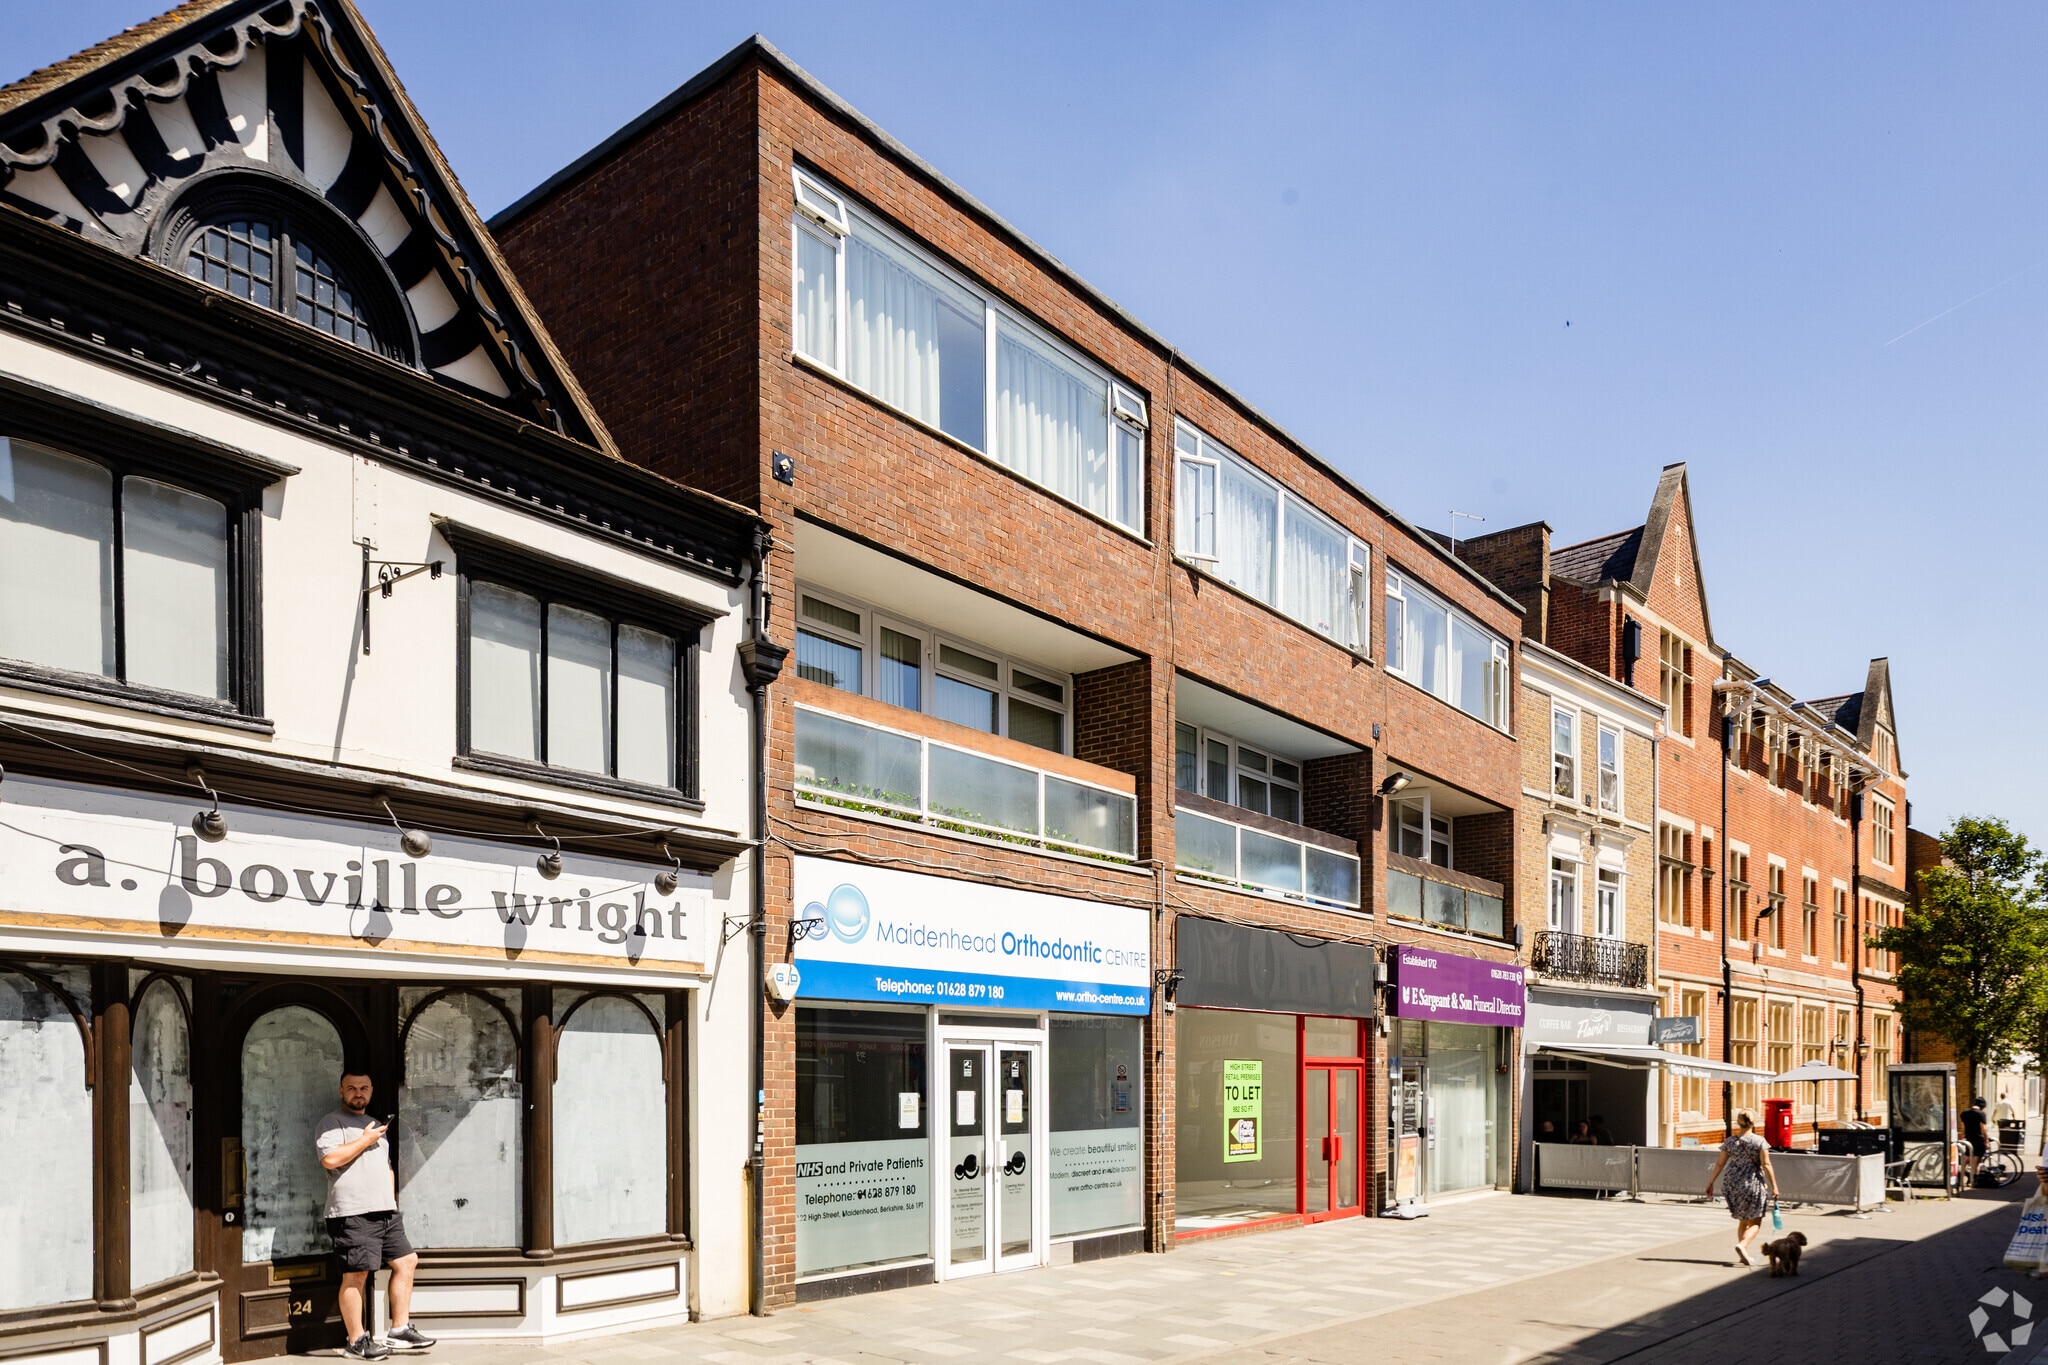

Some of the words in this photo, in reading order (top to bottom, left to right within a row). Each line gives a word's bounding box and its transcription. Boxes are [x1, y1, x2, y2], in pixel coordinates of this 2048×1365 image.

[55, 843, 137, 890] a.
[176, 834, 463, 919] boville
[491, 887, 687, 944] wright
[876, 920, 996, 953] Maidenhead
[1001, 931, 1102, 964] Orthodontic
[1105, 949, 1147, 968] CENTRE
[875, 977, 935, 996] Telephone:
[937, 980, 967, 997] 01628
[968, 983, 986, 998] 879
[988, 985, 1004, 999] 180
[1056, 990, 1146, 1007] www.ortho-centre.co.uk
[1419, 988, 1451, 1012] Sargeant
[1451, 992, 1458, 1009] &
[1459, 993, 1473, 1011] Son
[1473, 995, 1496, 1013] Funeral
[1496, 998, 1521, 1016] Directors
[1539, 1018, 1560, 1030] COFFEE
[1560, 1020, 1571, 1030] BAR
[1616, 1023, 1647, 1034] RESTAURANT
[1225, 1086, 1239, 1101] TO
[1243, 1086, 1261, 1100] LET
[1062, 1146, 1086, 1156] create
[1087, 1143, 1117, 1154] beautiful
[1117, 1142, 1137, 1151] smiles
[796, 1162, 823, 1178] NHS
[824, 1162, 846, 1175] and
[849, 1161, 884, 1173] Private
[886, 1157, 924, 1170] Patients
[1071, 1169, 1091, 1178] discreet
[1102, 1166, 1120, 1174] invisible
[805, 1190, 855, 1206] Telephone:
[884, 1185, 899, 1197] 879
[902, 1184, 916, 1195] 180
[808, 1213, 821, 1222] High
[822, 1211, 840, 1219] Street,
